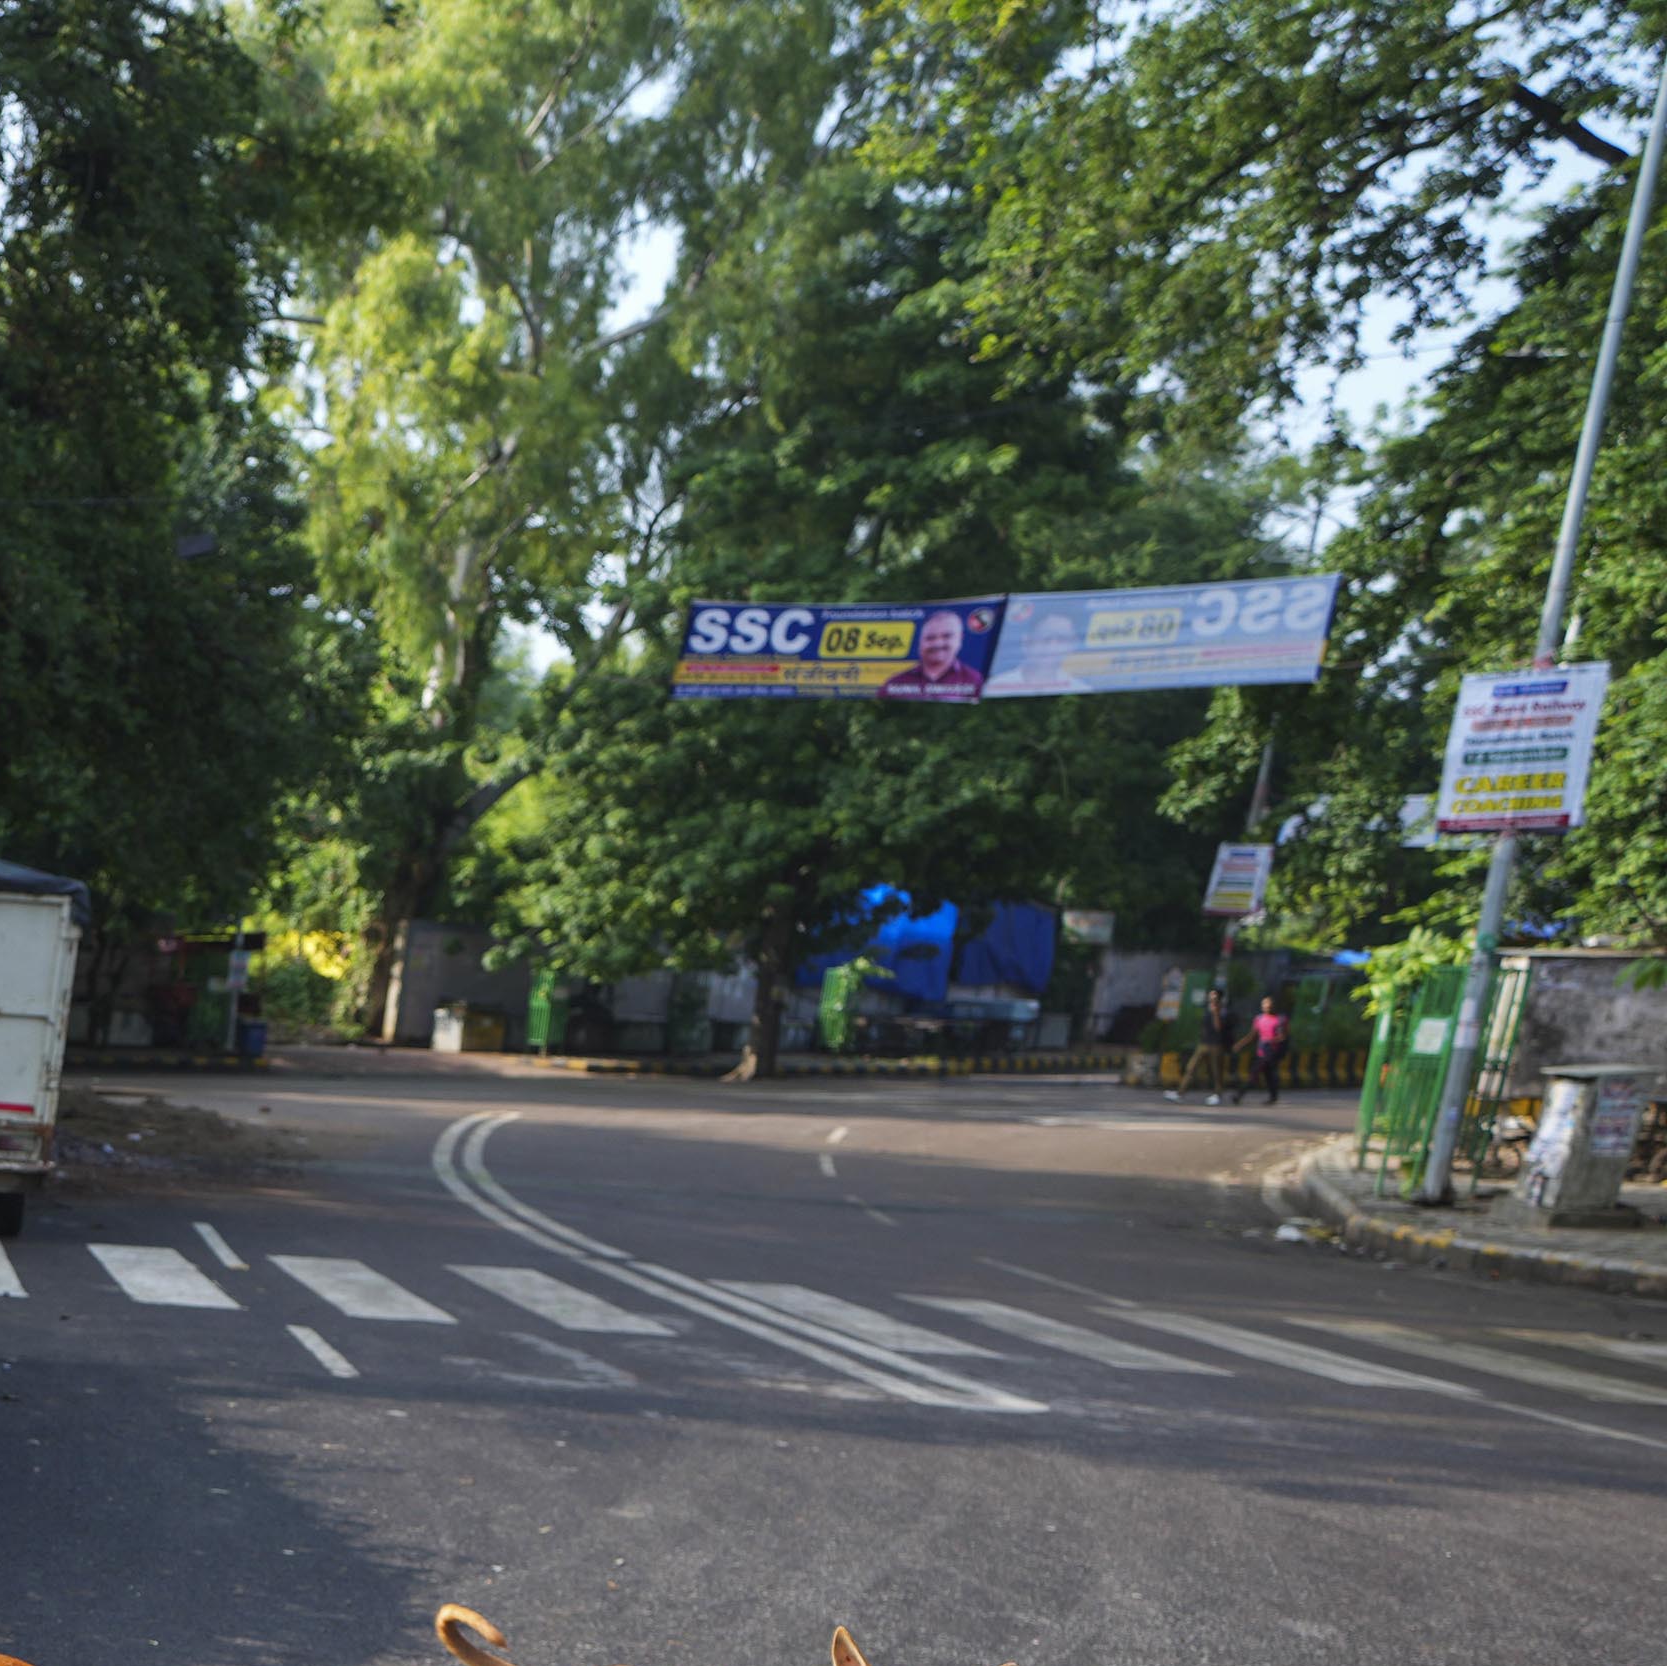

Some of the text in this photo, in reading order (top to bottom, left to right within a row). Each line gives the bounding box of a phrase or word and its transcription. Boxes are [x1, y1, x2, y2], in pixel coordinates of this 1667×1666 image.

[689, 607, 816, 655] SSC
[825, 626, 905, 653] 08 Sep.
[1455, 771, 1567, 795] CAREER
[1451, 794, 1564, 815] COACHING
